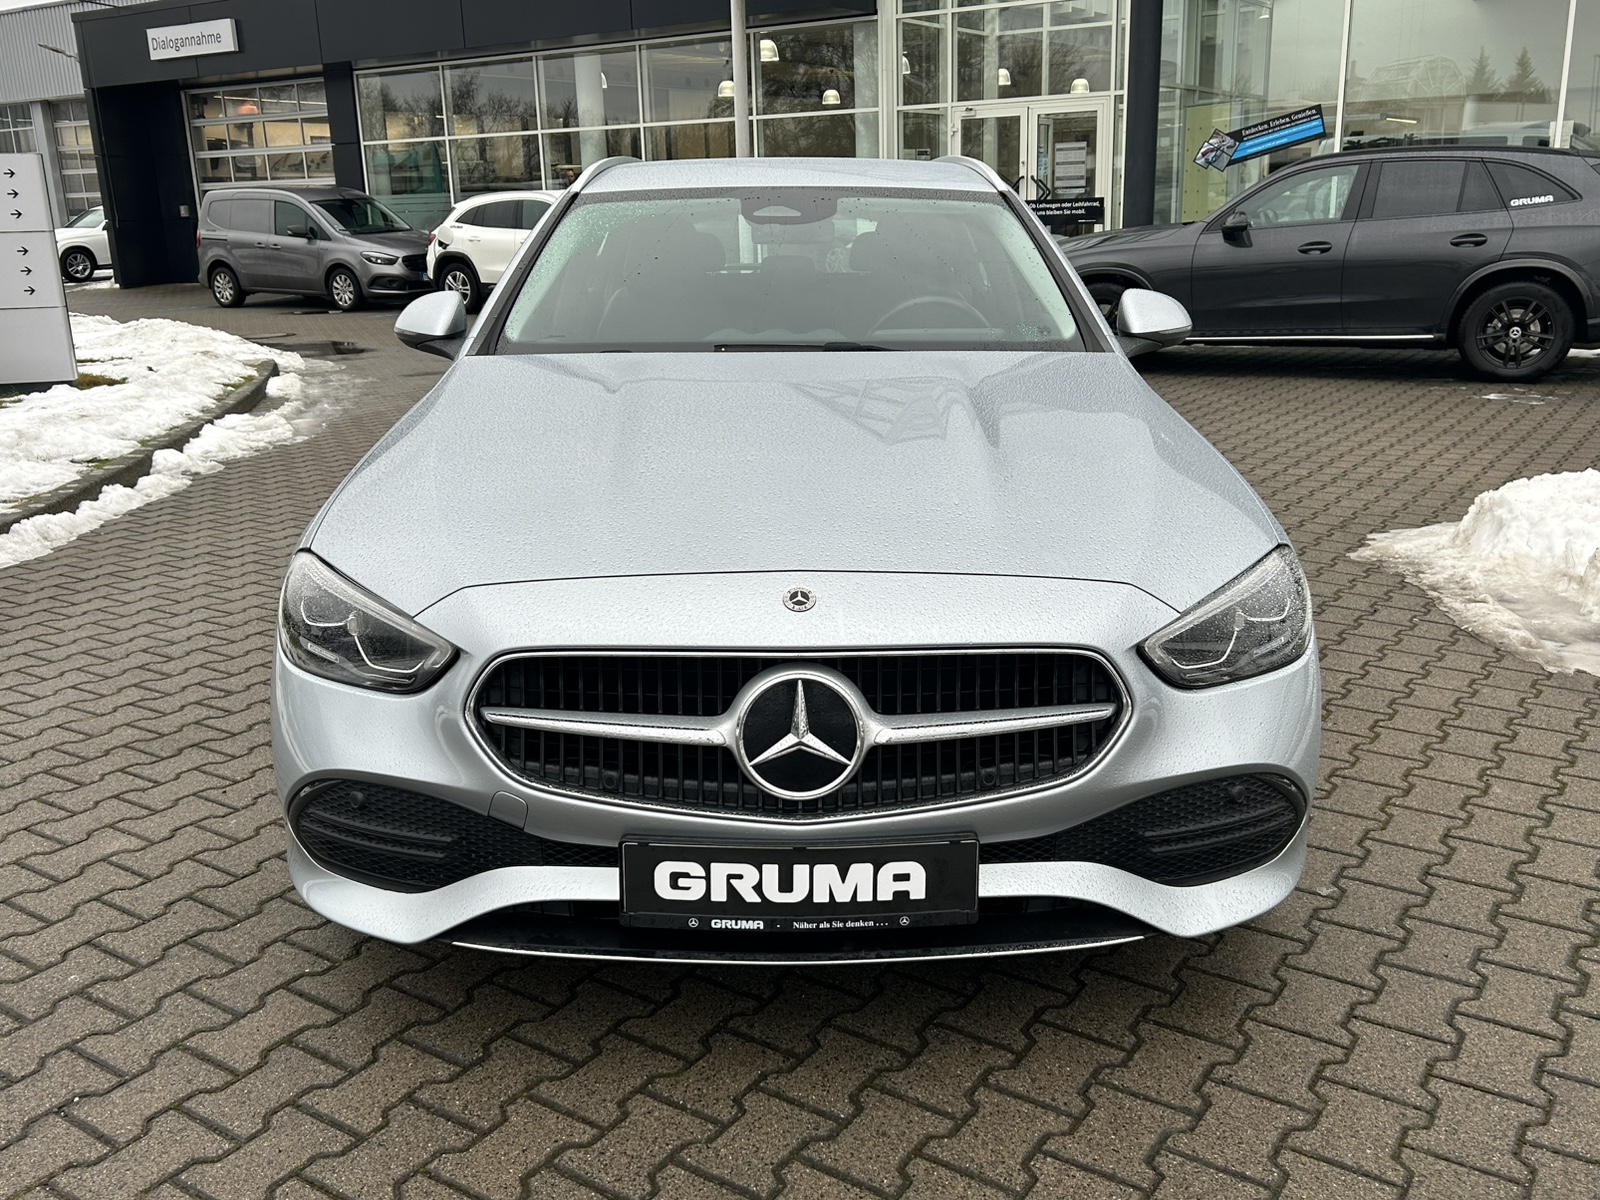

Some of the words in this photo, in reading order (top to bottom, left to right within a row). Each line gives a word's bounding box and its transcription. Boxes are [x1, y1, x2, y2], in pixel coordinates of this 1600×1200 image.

[151, 31, 222, 52] Dialogannahme
[1242, 124, 1270, 136] Entdecken.
[1269, 117, 1291, 128] Erleben.
[1291, 109, 1317, 120] Genießen.
[1510, 194, 1554, 207] GRUMA
[654, 860, 926, 903] GRUMA
[711, 919, 764, 930] GRUMA
[792, 921, 818, 929] Näher
[819, 920, 831, 929] als
[831, 920, 845, 928] Sie
